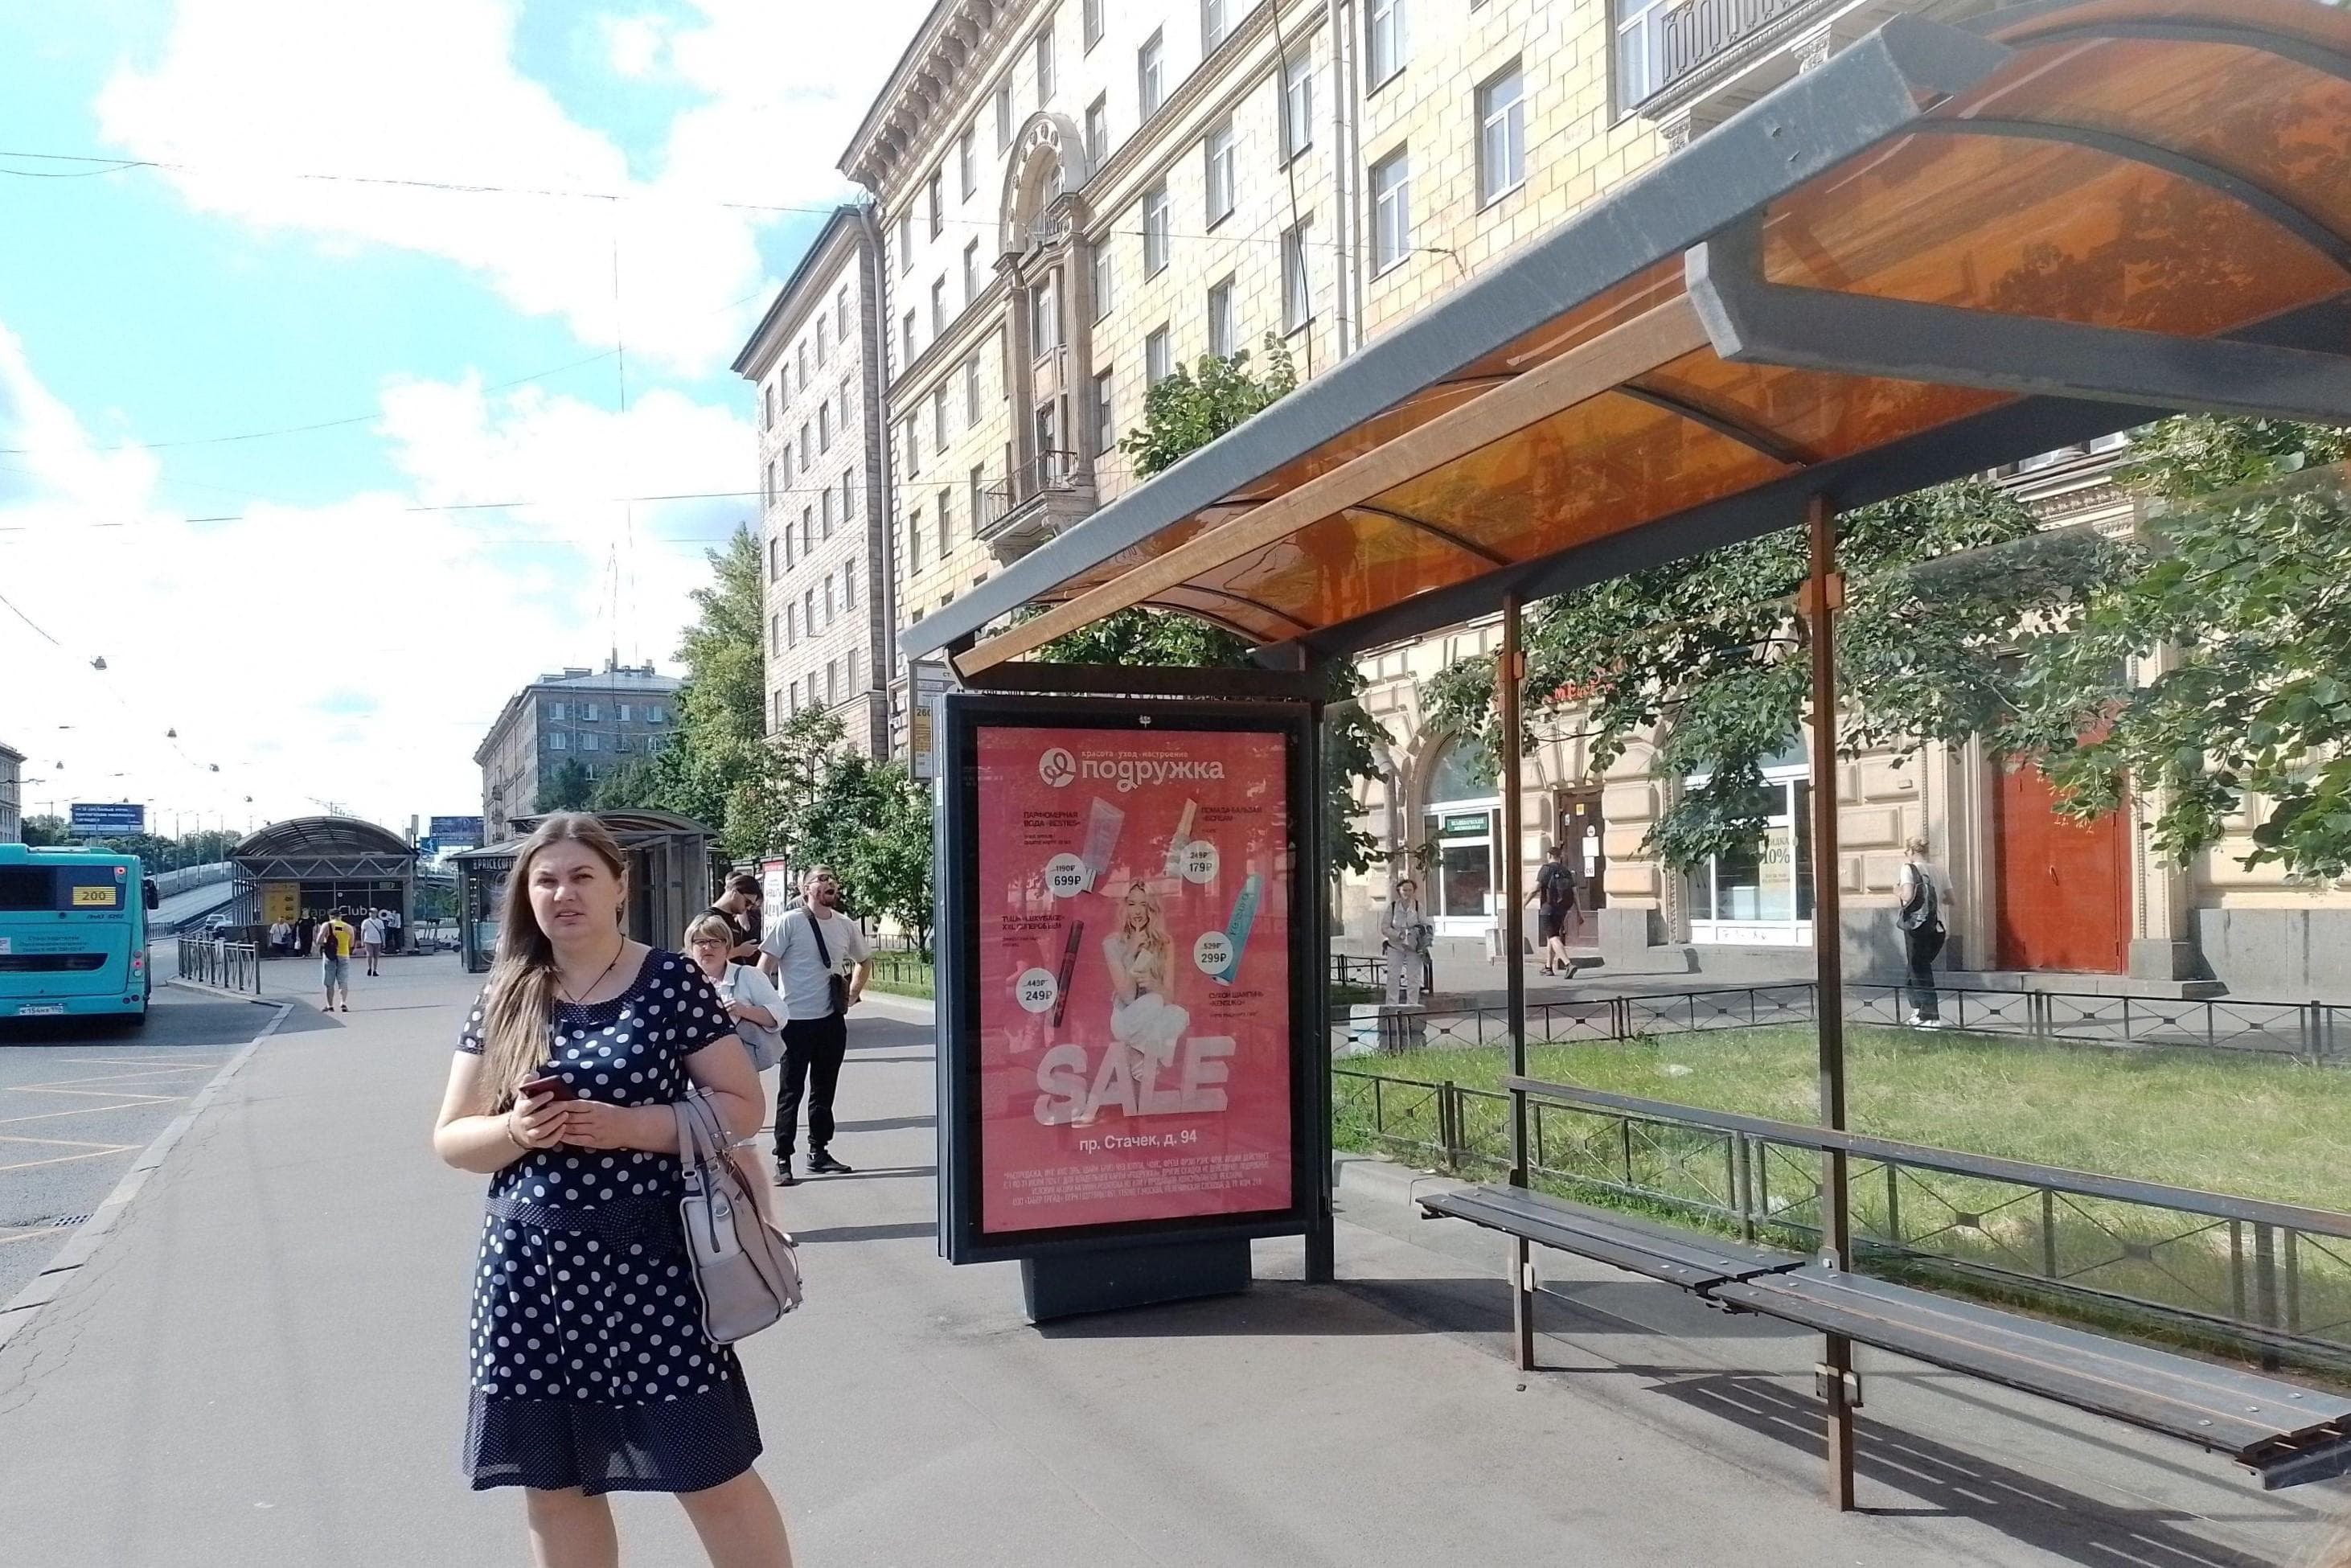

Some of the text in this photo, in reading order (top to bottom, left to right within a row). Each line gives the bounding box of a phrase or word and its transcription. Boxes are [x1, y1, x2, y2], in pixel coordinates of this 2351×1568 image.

[1118, 751, 1138, 759] уход
[1082, 760, 1225, 793] подружка
[498, 858, 515, 869] COFF
[82, 891, 105, 900] 200
[338, 905, 367, 916] Club
[1034, 1036, 1237, 1127] SALE
[1080, 1129, 1197, 1154] пр. Стачек, д. 94
